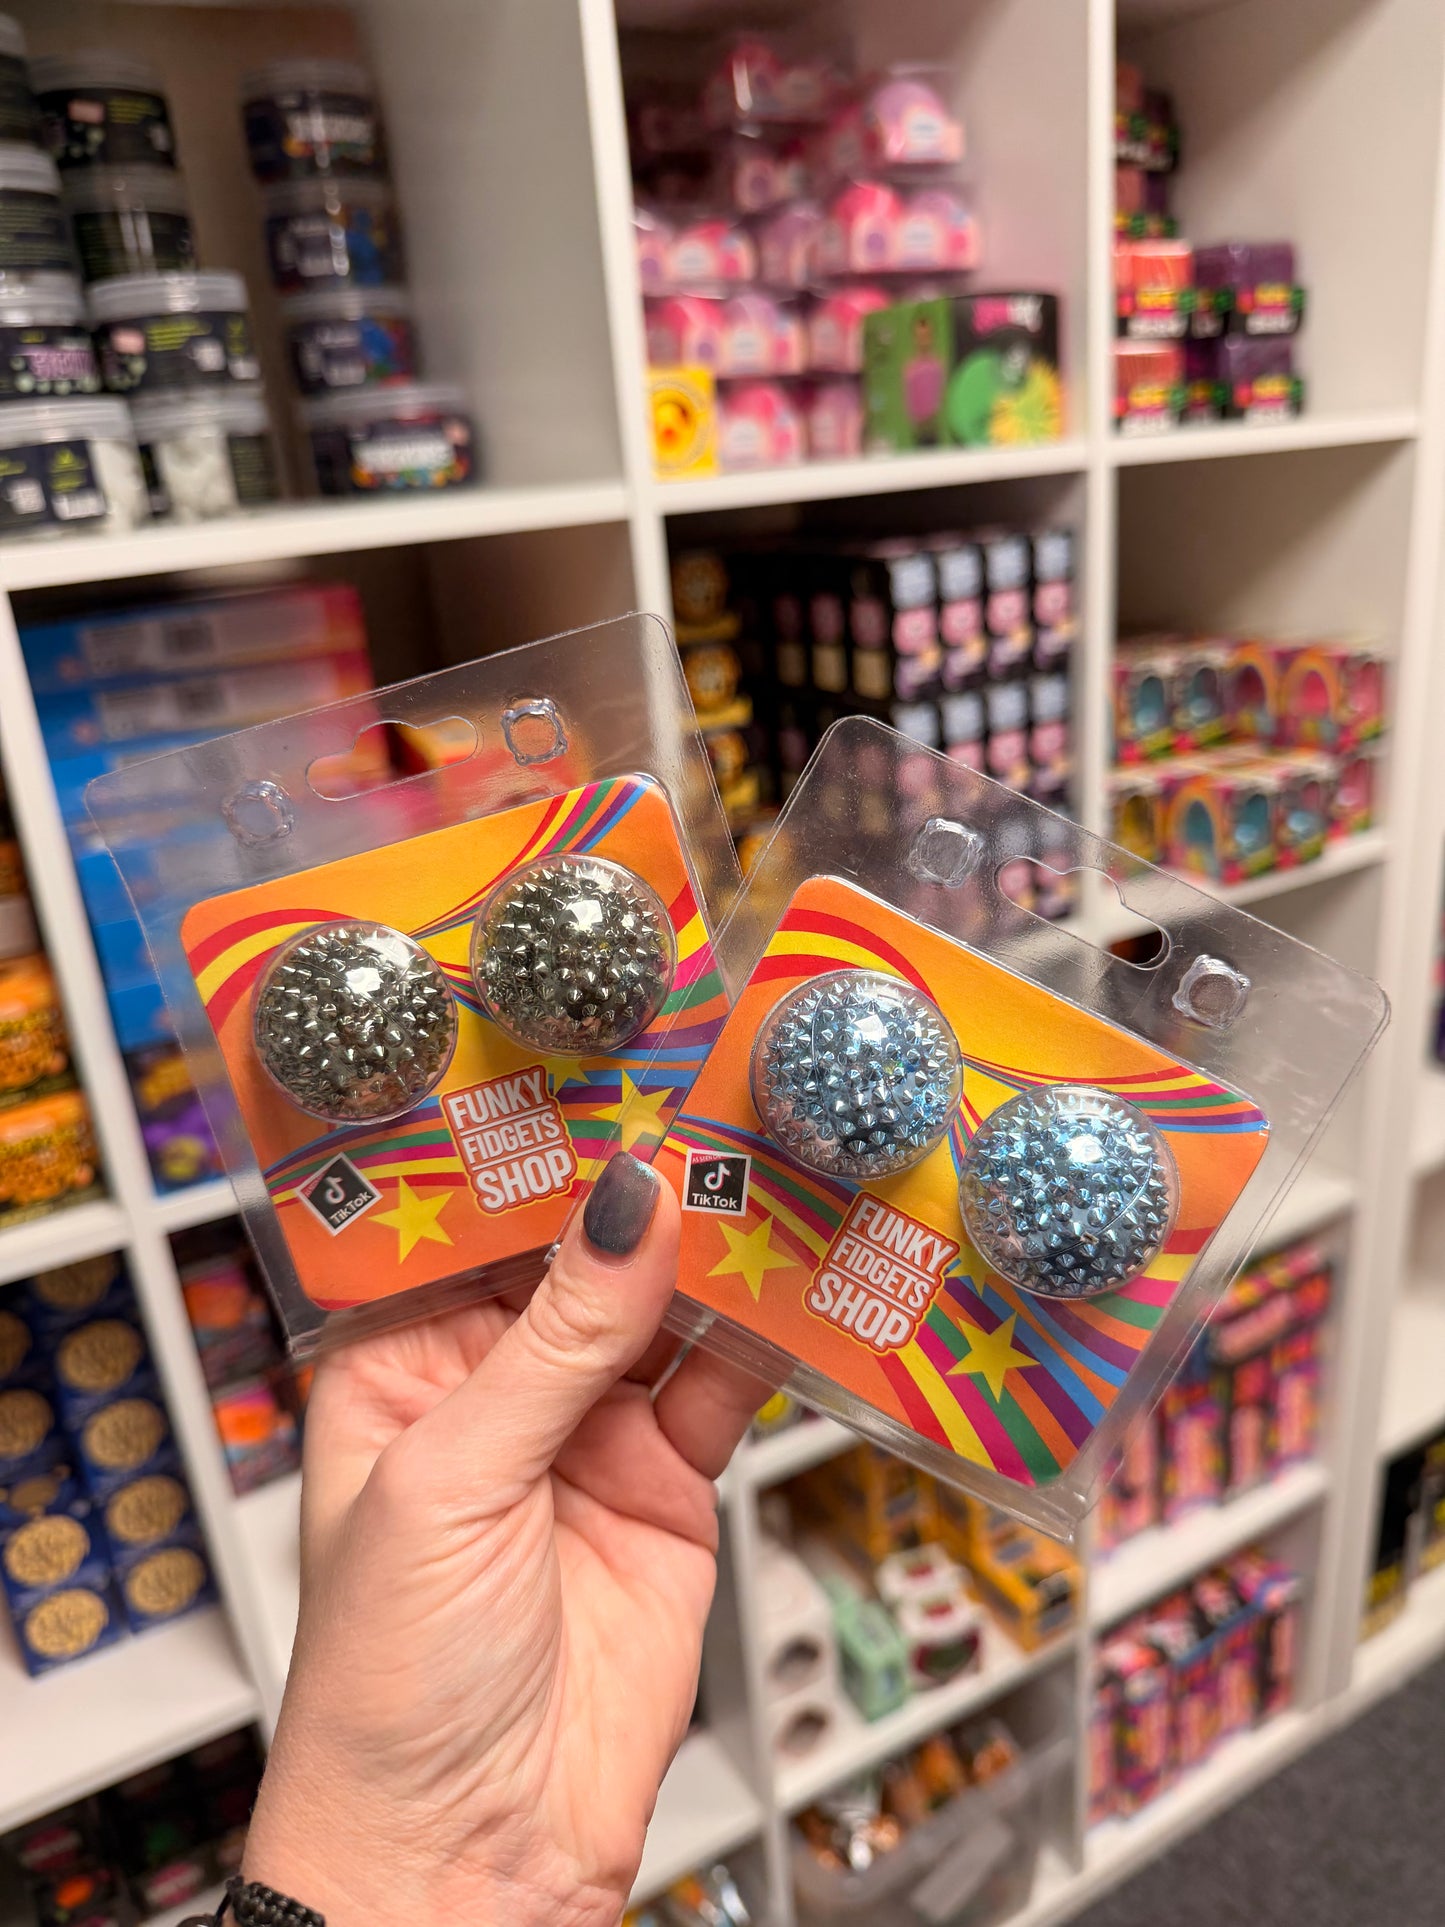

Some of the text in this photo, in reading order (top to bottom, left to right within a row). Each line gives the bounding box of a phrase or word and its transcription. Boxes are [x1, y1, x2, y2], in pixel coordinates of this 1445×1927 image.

[447, 1070, 544, 1130] FUNKY
[461, 1111, 561, 1165] FIDGETS
[329, 1191, 373, 1224] TikTok
[476, 1148, 572, 1209] SHOP
[692, 1192, 738, 1209] TikTok
[850, 1198, 954, 1274] FUNKY
[831, 1236, 930, 1308] FIDGETS
[810, 1272, 910, 1348] SHOP
